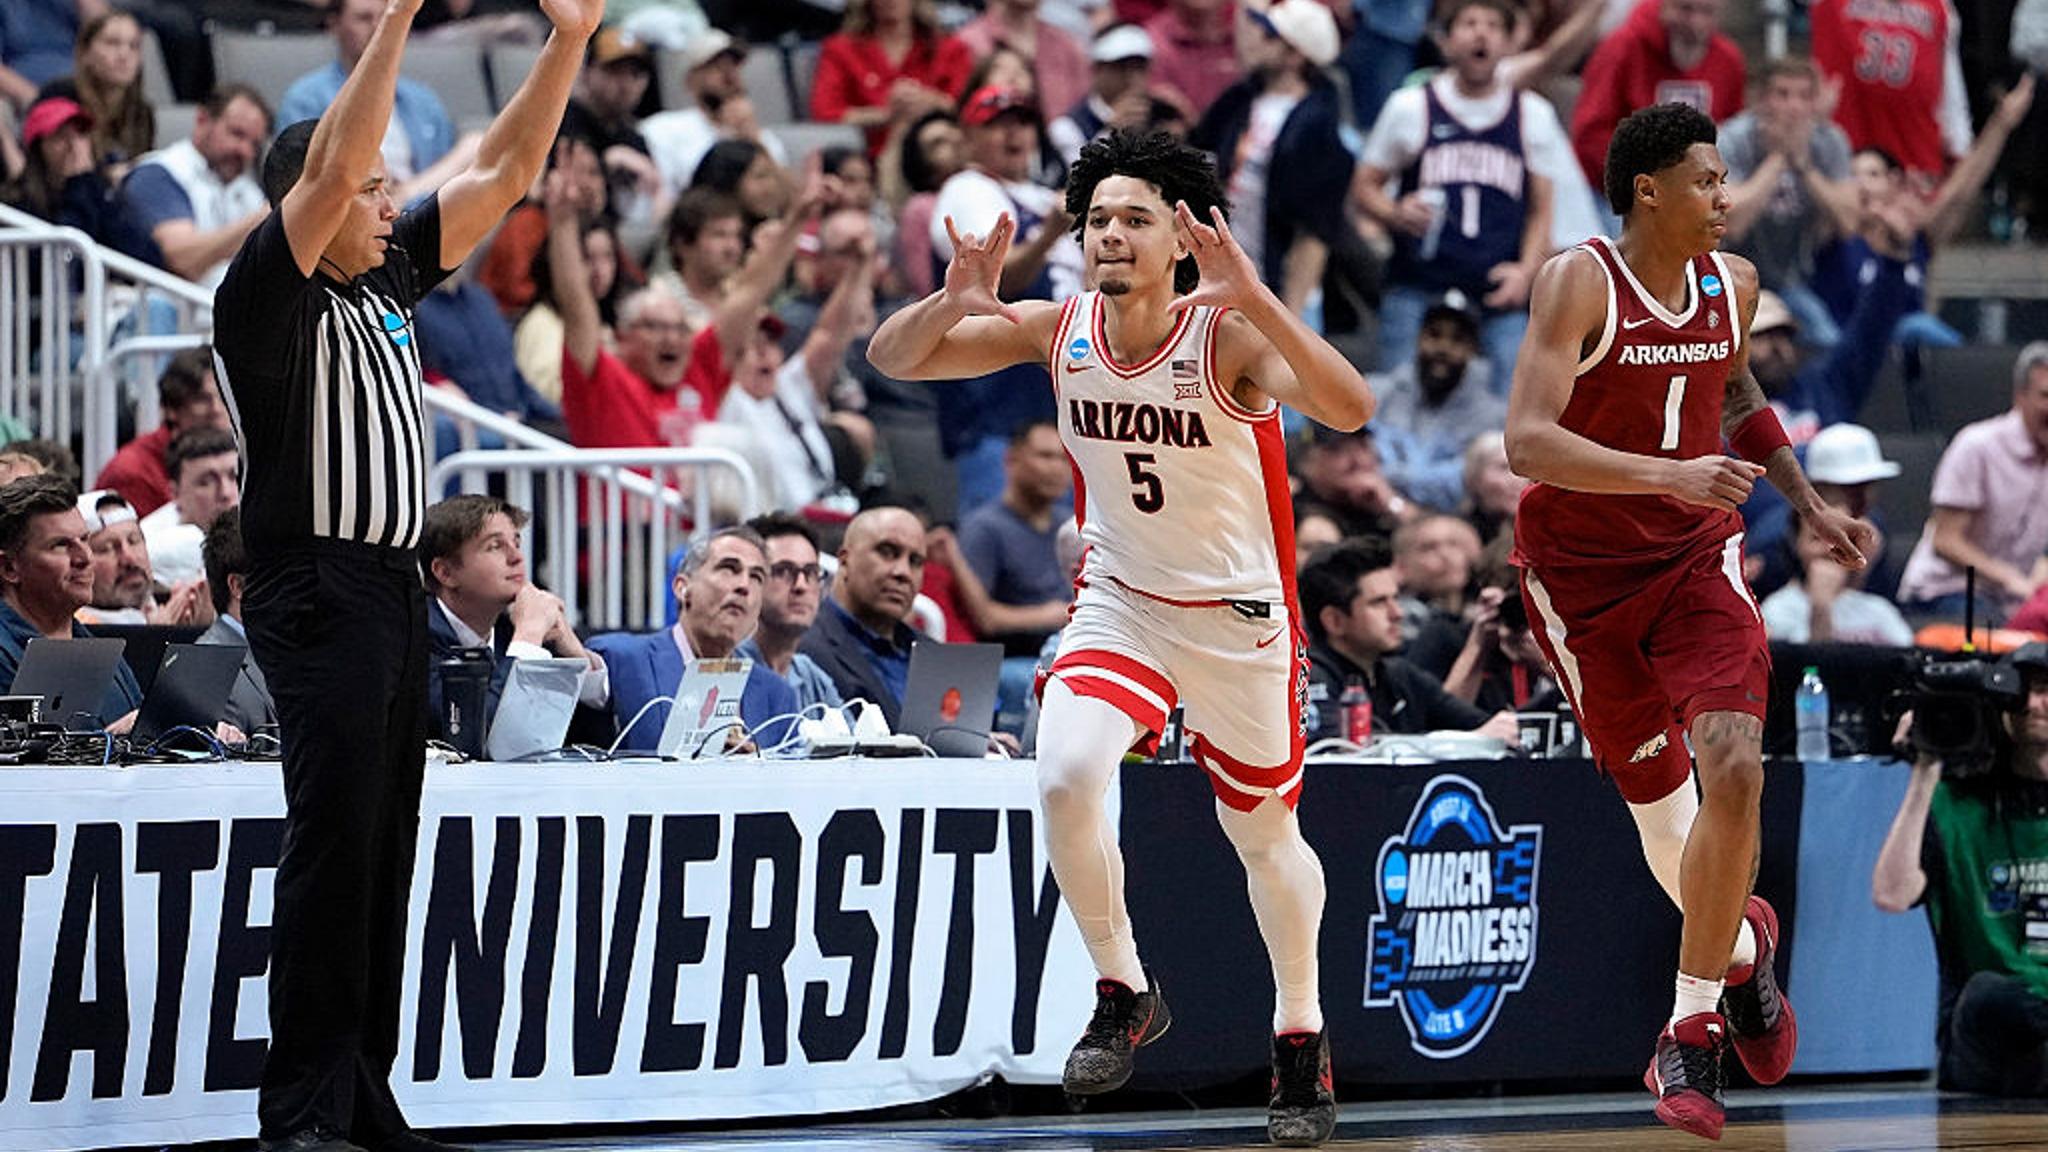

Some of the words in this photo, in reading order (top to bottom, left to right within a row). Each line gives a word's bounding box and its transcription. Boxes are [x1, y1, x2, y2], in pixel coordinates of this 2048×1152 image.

[1856, 29, 1914, 86] 33
[1461, 186, 1480, 239] 1
[1617, 340, 1729, 365] ARKANSAS
[1069, 399, 1212, 448] ARIZONA
[1661, 375, 1687, 450] 1
[1123, 452, 1165, 514] 5
[1406, 851, 1492, 908] MARCH
[413, 808, 1061, 1081] NIVERSITY
[1413, 907, 1531, 967] MADNESS
